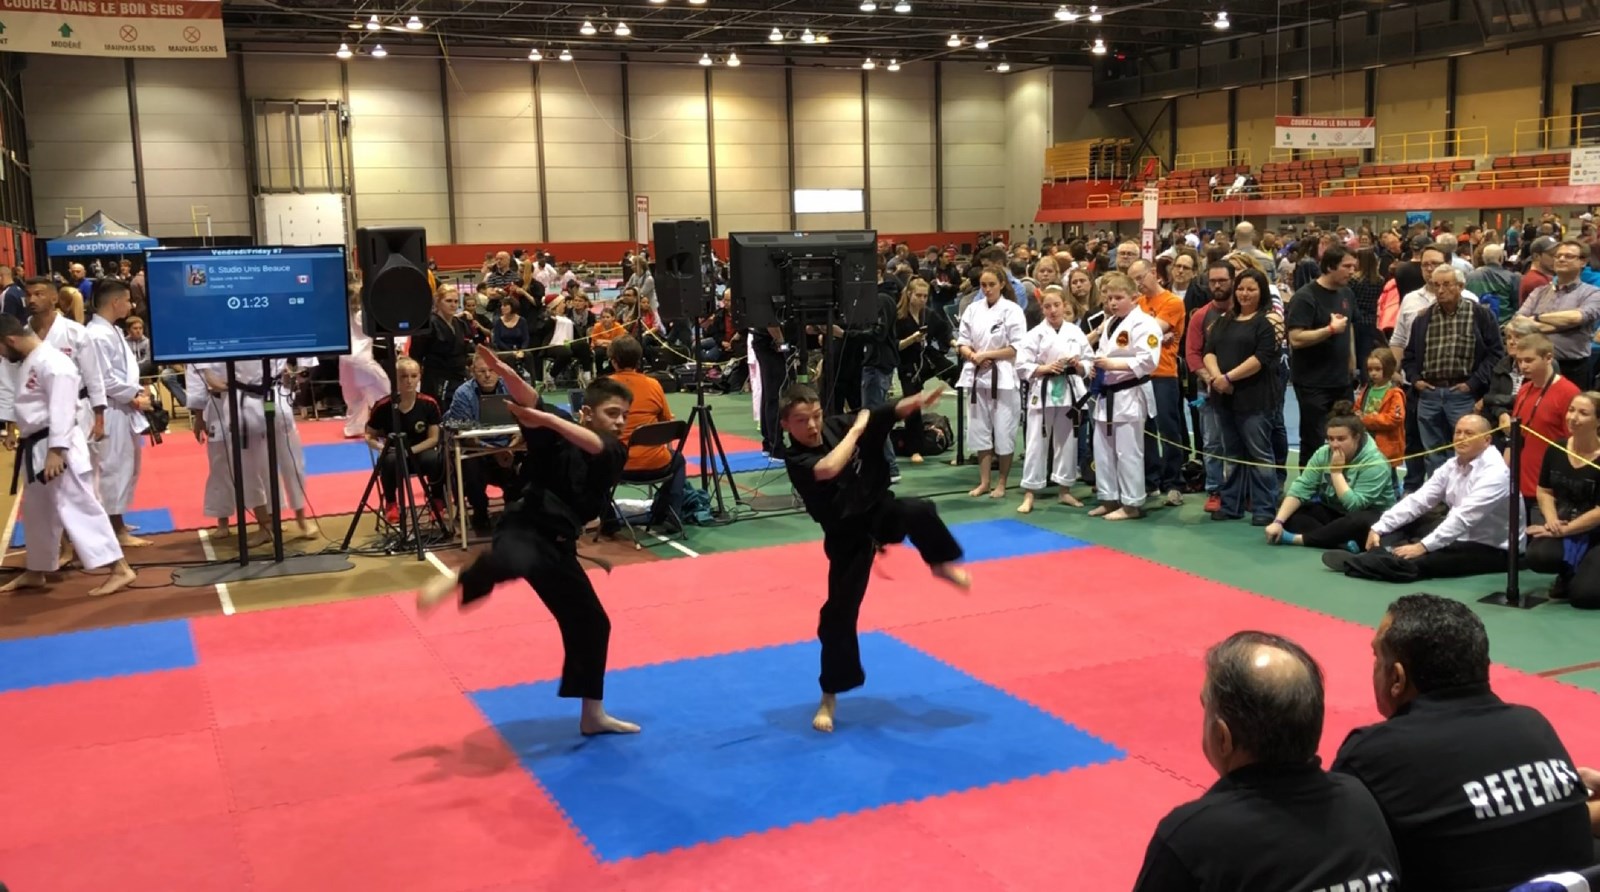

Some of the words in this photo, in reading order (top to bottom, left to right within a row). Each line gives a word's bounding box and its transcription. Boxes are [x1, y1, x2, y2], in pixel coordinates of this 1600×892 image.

[3, 0, 57, 10] COUREZ
[60, 0, 97, 13] DANS
[100, 3, 117, 14] LE
[120, 3, 147, 15] BON
[150, 4, 185, 16] SENS
[168, 45, 200, 53] MAUVAIS
[200, 45, 218, 53] SENS
[66, 241, 140, 253] apexphysio.ca
[208, 266, 215, 274] 6.
[218, 265, 242, 274] Studio
[244, 264, 261, 273] Unis
[262, 264, 291, 272] Beauce
[242, 296, 270, 309] 1:23
